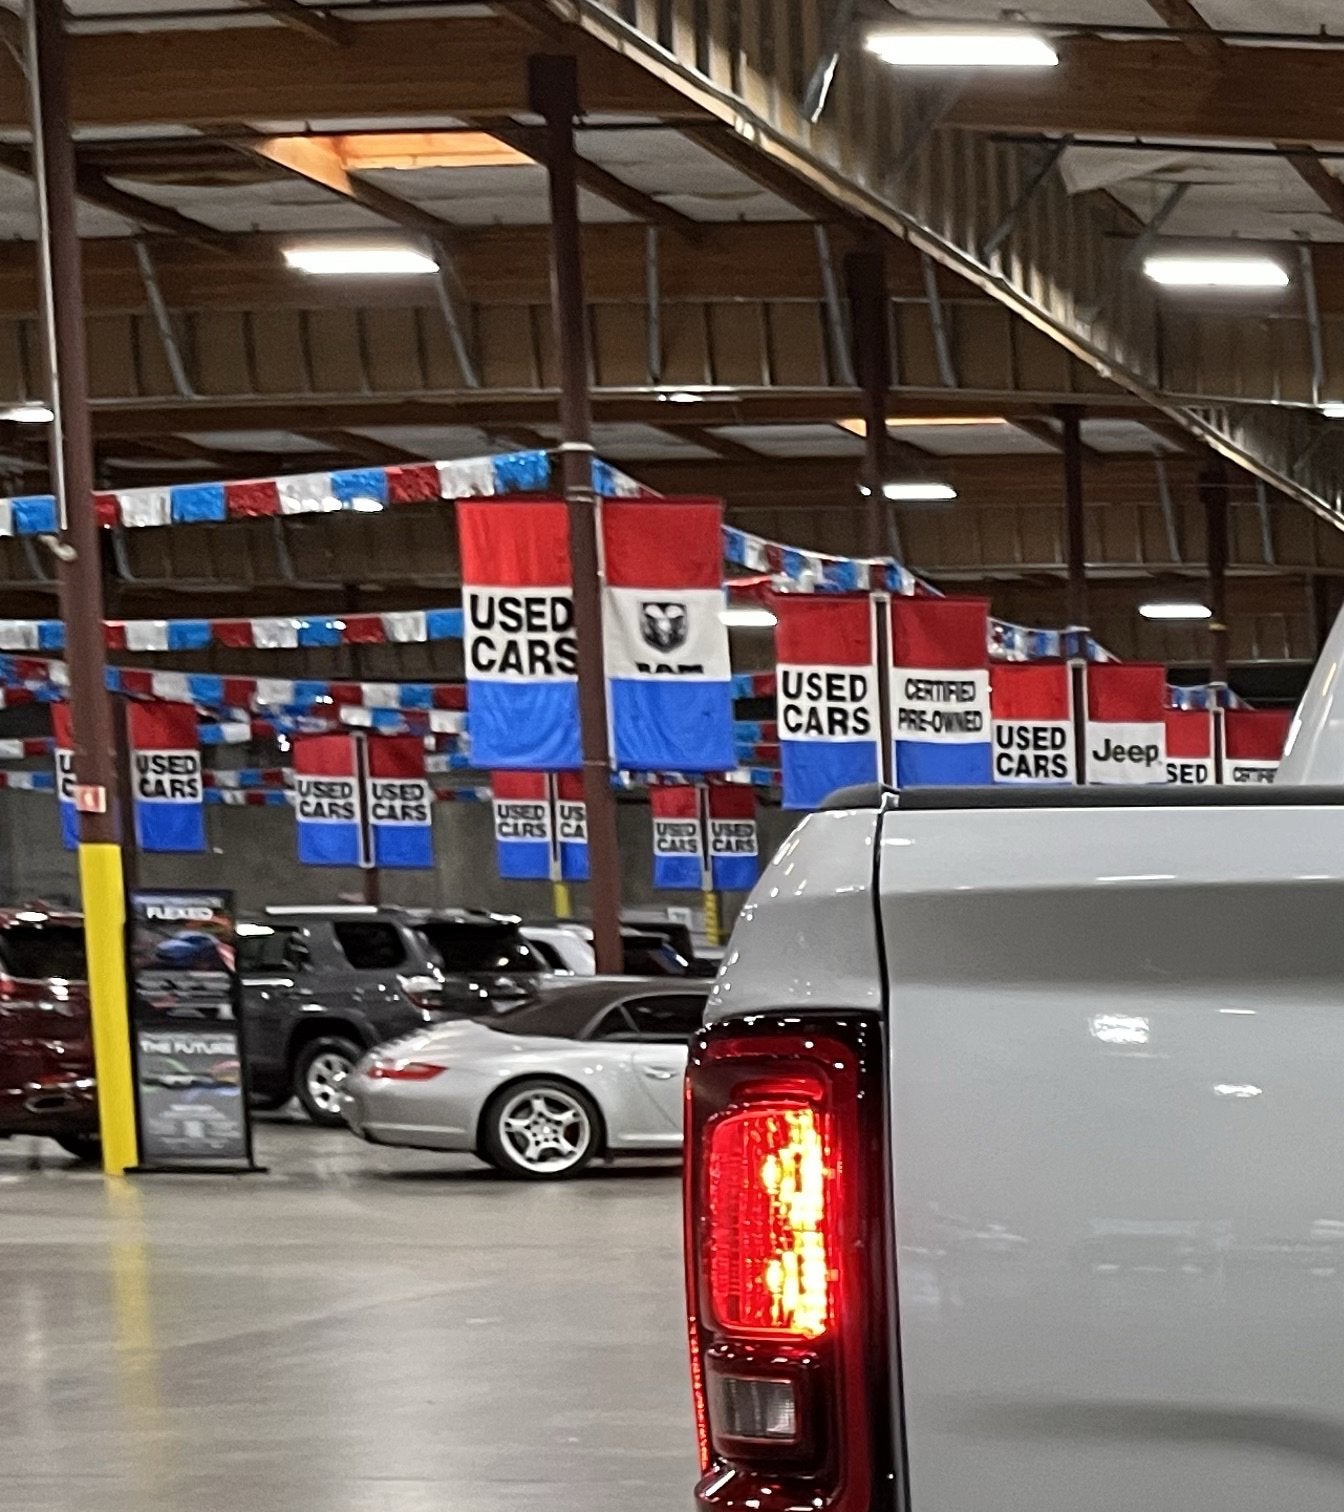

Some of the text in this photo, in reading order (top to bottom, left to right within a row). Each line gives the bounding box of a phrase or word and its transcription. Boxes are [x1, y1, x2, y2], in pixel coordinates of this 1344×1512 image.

[470, 594, 574, 633] USED
[471, 636, 578, 675] CARS
[782, 670, 867, 702] USED
[905, 678, 976, 702] CERTIFIED
[784, 704, 870, 735] CARS
[899, 707, 983, 733] PRE-OWNED
[996, 725, 1067, 750] USED
[1092, 738, 1159, 767] Jeep
[136, 755, 197, 775] USED
[996, 753, 1068, 778] CARS
[1167, 763, 1208, 784] SED
[139, 778, 198, 798] CARS
[299, 781, 352, 799] USED
[372, 783, 425, 800] USED
[300, 802, 355, 820] CARS
[372, 803, 427, 821] CARS
[497, 804, 545, 820] USED
[560, 805, 584, 820] US
[560, 823, 585, 838] CA
